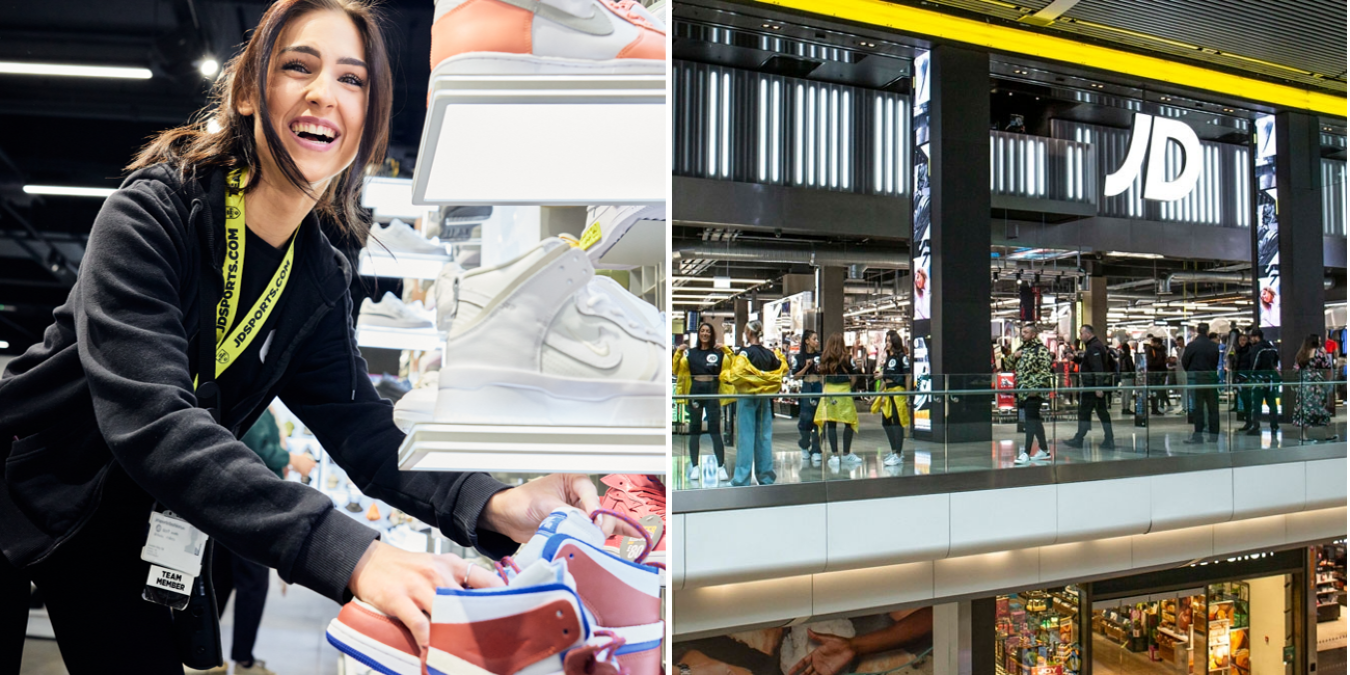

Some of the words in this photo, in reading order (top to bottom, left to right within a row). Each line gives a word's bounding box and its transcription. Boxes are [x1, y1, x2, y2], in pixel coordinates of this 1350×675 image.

[1103, 112, 1201, 201] JD
[217, 228, 239, 333] JDSPORTS.COM
[233, 260, 290, 348] JDSPORTS.COM
[156, 577, 185, 591] MEMBER
[162, 570, 182, 582] TEAM
